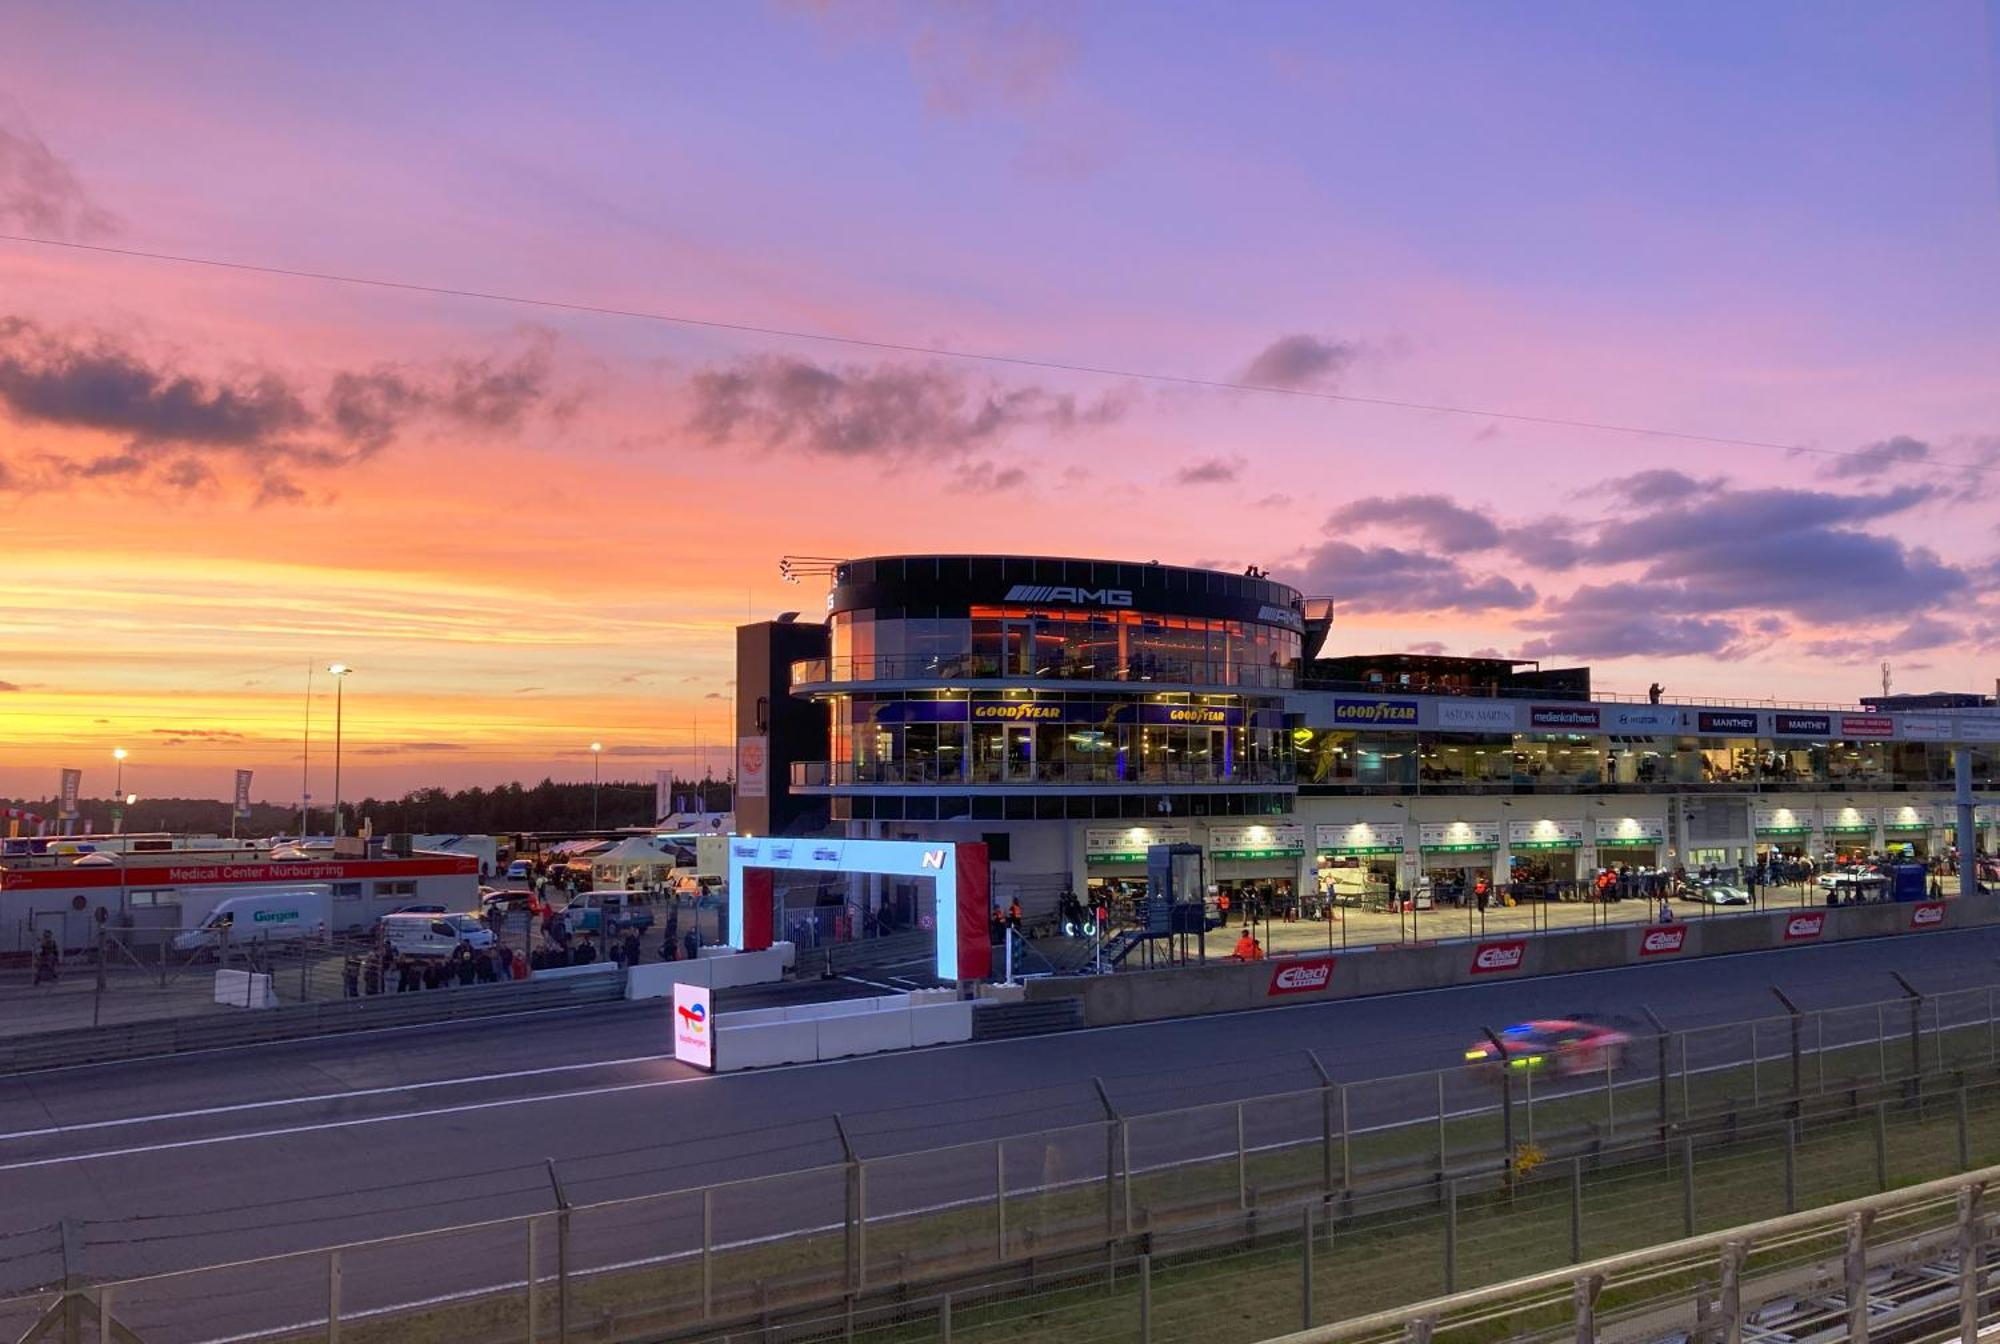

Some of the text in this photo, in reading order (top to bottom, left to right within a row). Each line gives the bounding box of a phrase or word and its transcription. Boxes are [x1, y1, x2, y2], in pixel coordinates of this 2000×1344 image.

[1045, 586, 1133, 606] AMG
[975, 703, 1061, 720] GOODYEAR
[1336, 702, 1416, 723] GOODYEAR
[1534, 711, 1597, 724] medienkraftwerk
[1712, 718, 1753, 728] MANTHEY
[1788, 720, 1827, 730] MANTHEY
[169, 864, 344, 880] Medical Center Nürburgring
[1276, 964, 1329, 989] Eibach
